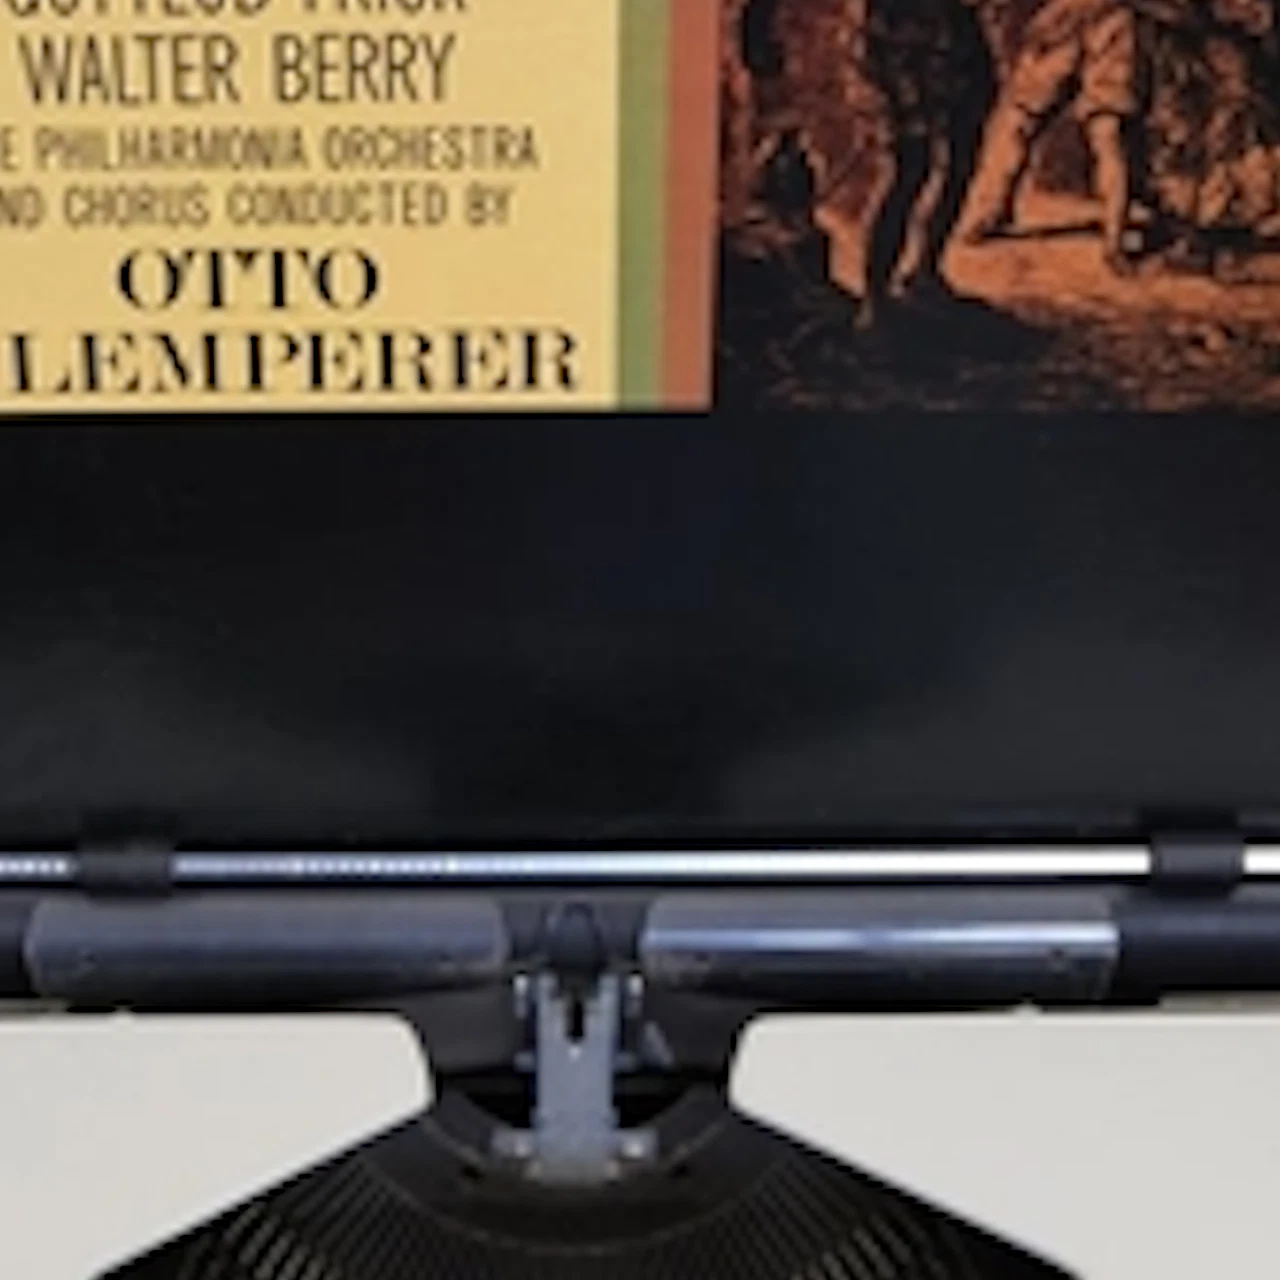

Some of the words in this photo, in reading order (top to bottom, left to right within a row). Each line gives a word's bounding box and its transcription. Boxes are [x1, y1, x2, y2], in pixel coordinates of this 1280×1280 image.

[16, 31, 242, 109] WALTER
[271, 30, 458, 106] BERRY
[32, 124, 310, 174] PHILHARMONIA
[320, 123, 540, 174] ORCHESTRA
[61, 180, 213, 233] CHORUS
[224, 179, 450, 230] CONDUCTED
[463, 179, 514, 230] BY
[116, 247, 380, 311] OTTO
